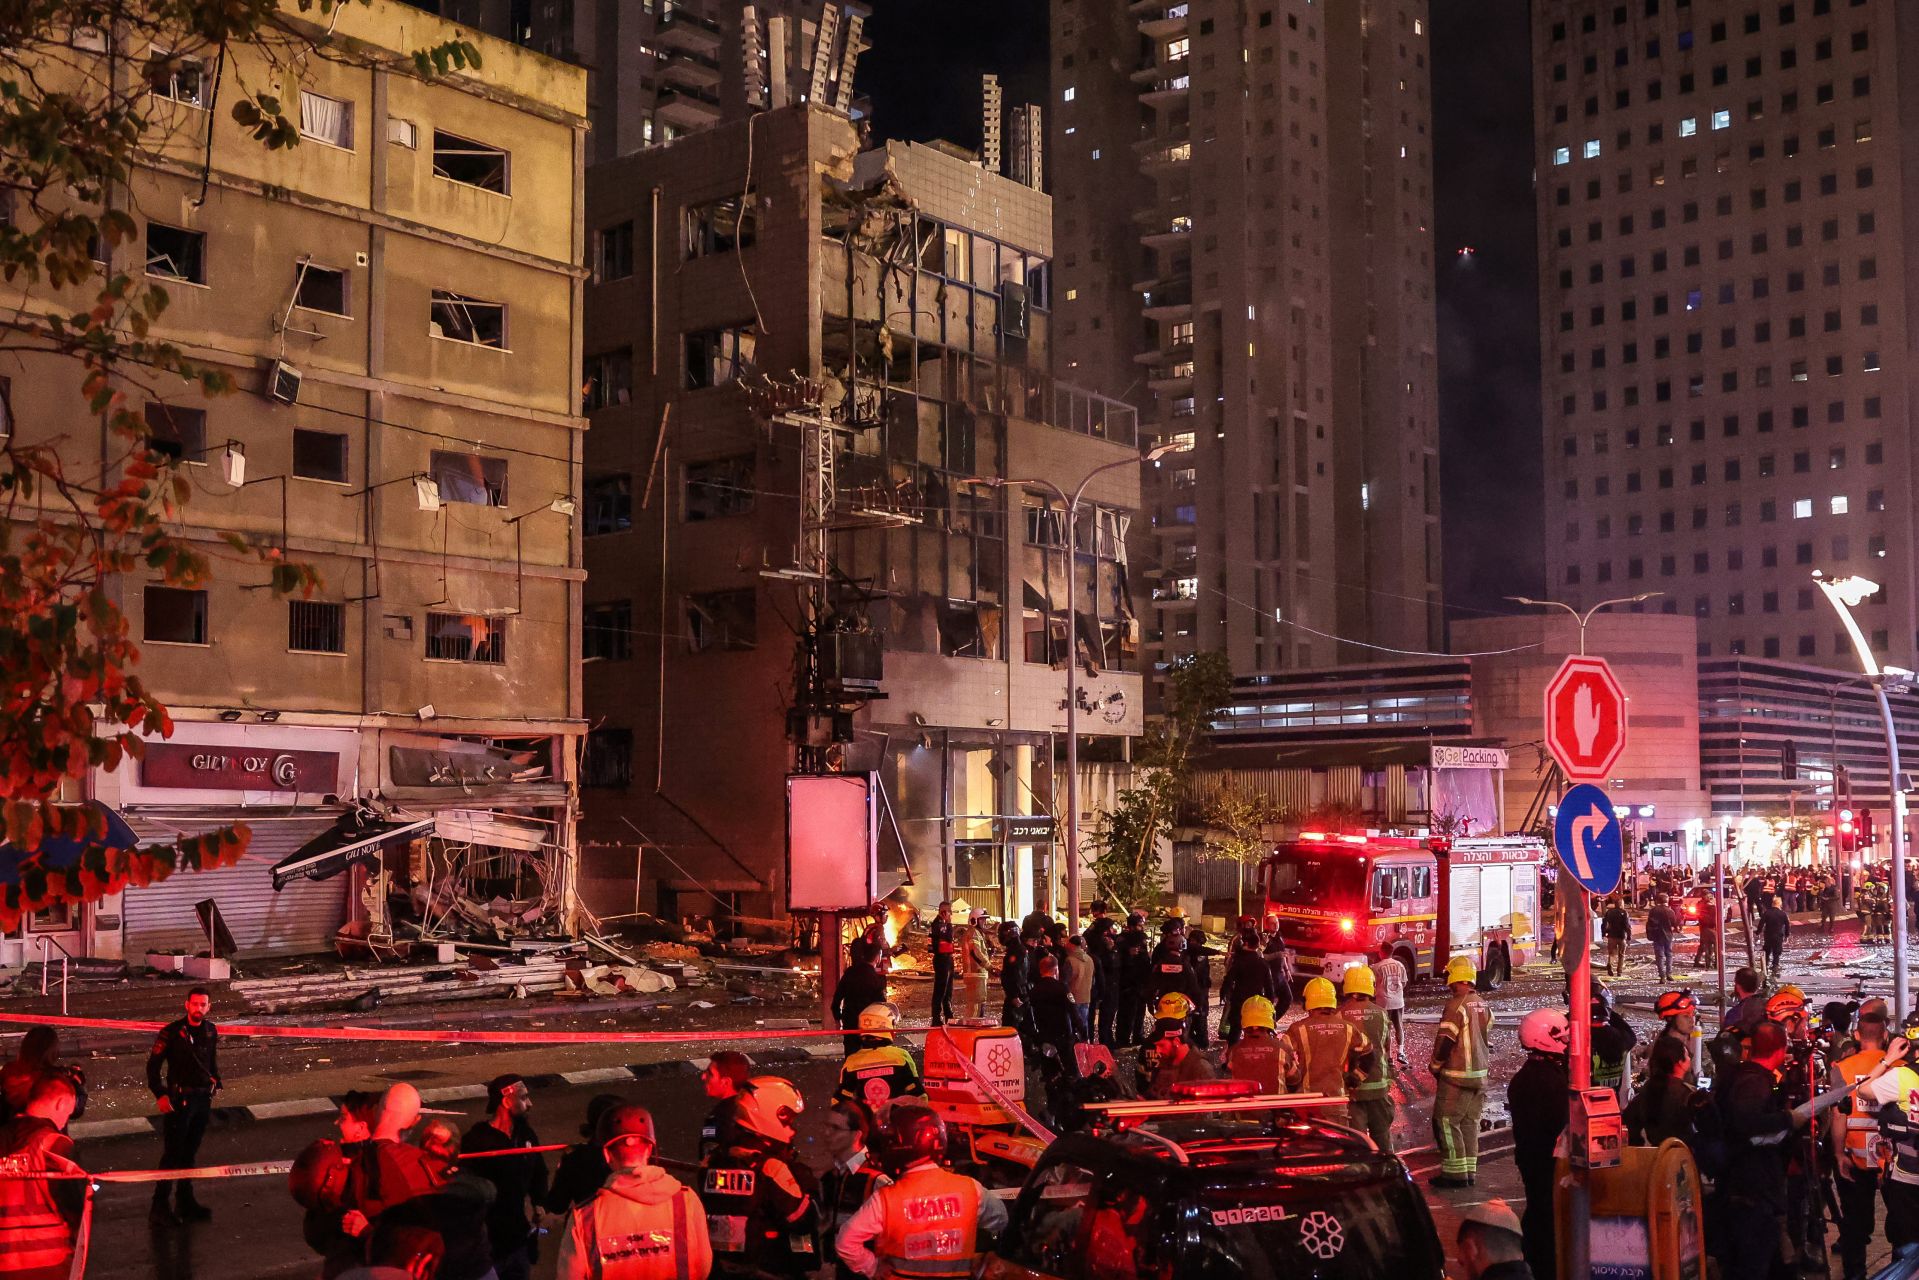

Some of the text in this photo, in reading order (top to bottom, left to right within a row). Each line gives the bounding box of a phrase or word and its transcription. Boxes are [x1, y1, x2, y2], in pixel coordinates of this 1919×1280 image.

[1013, 827, 1050, 835] יבואני רכב
[1463, 851, 1492, 862] והצלה
[1414, 932, 1425, 945] 102
[1001, 1079, 1020, 1088] איחוד
[1231, 1209, 1281, 1221] 1221
